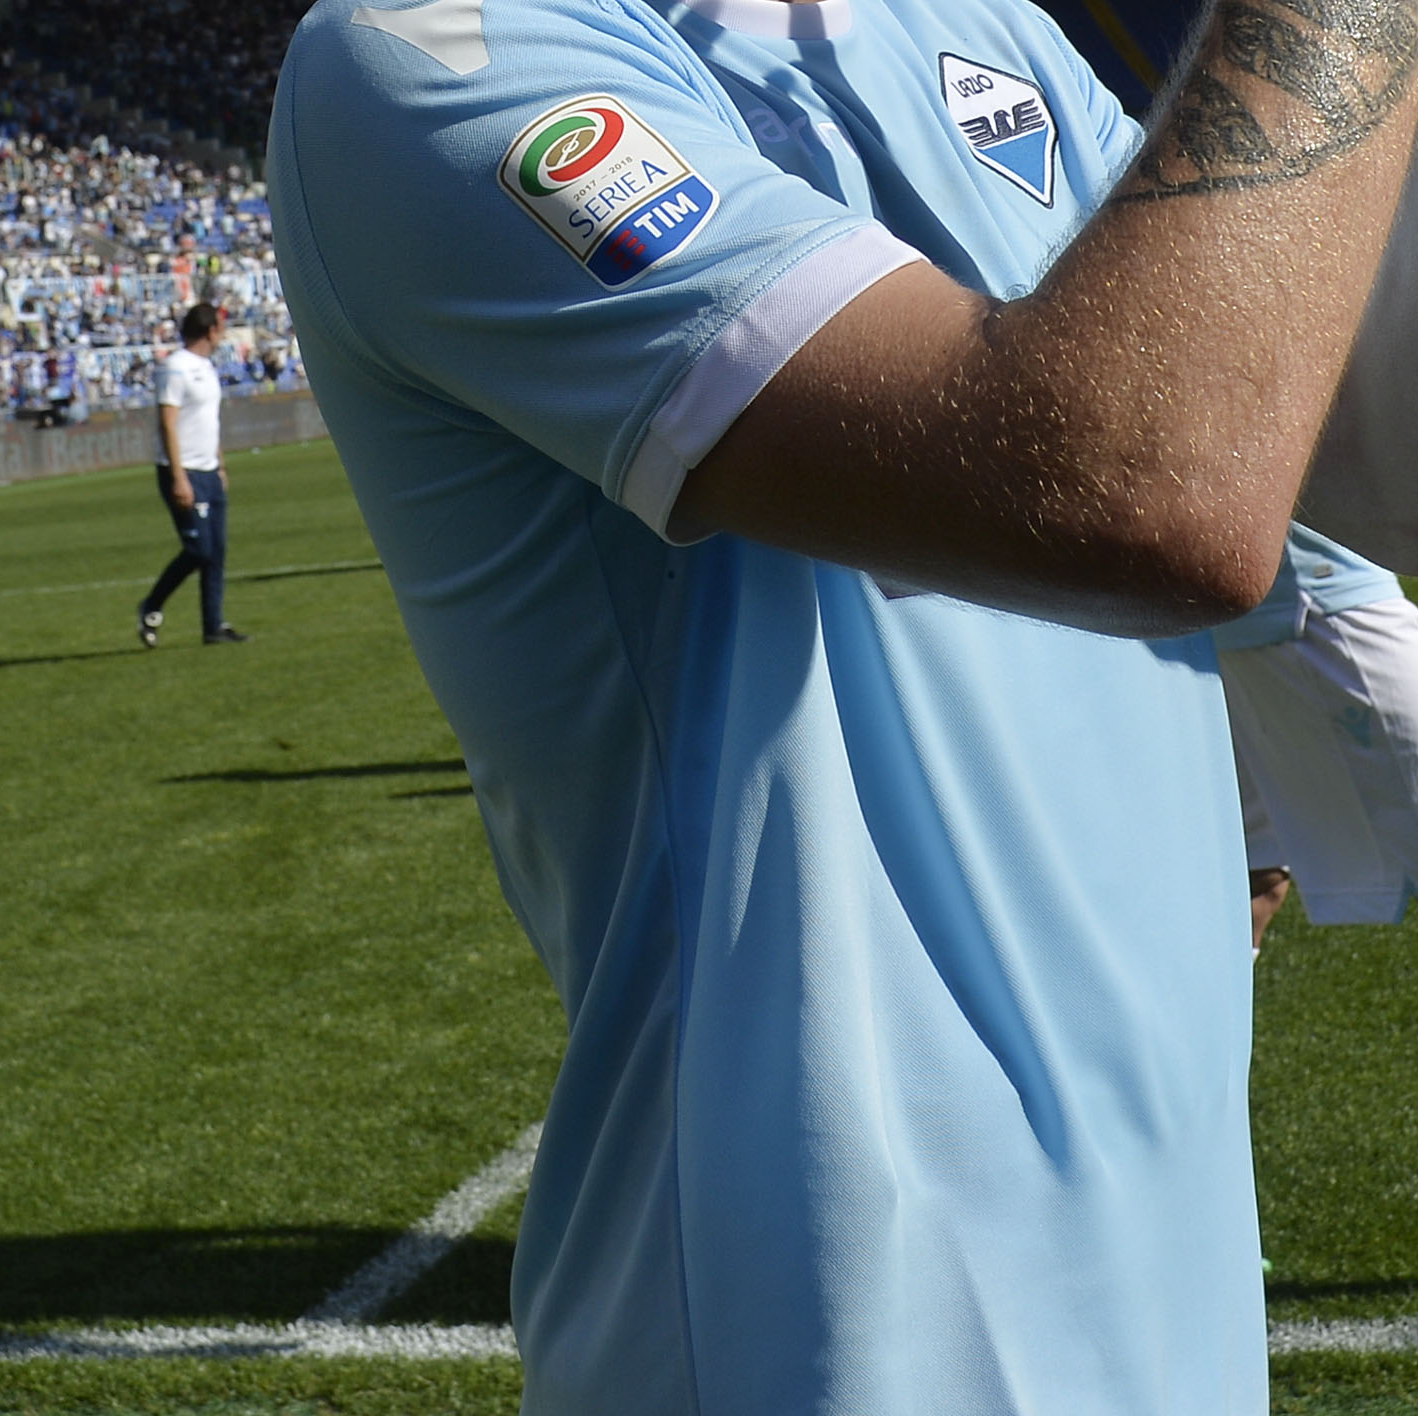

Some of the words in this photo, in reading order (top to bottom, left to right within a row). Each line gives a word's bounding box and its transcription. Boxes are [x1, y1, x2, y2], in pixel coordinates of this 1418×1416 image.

[951, 74, 994, 98] LAZIO
[568, 171, 646, 239] SERIE
[641, 160, 668, 184] A
[573, 180, 597, 202] 2017
[608, 156, 633, 174] 2018
[633, 191, 700, 239] TIM
